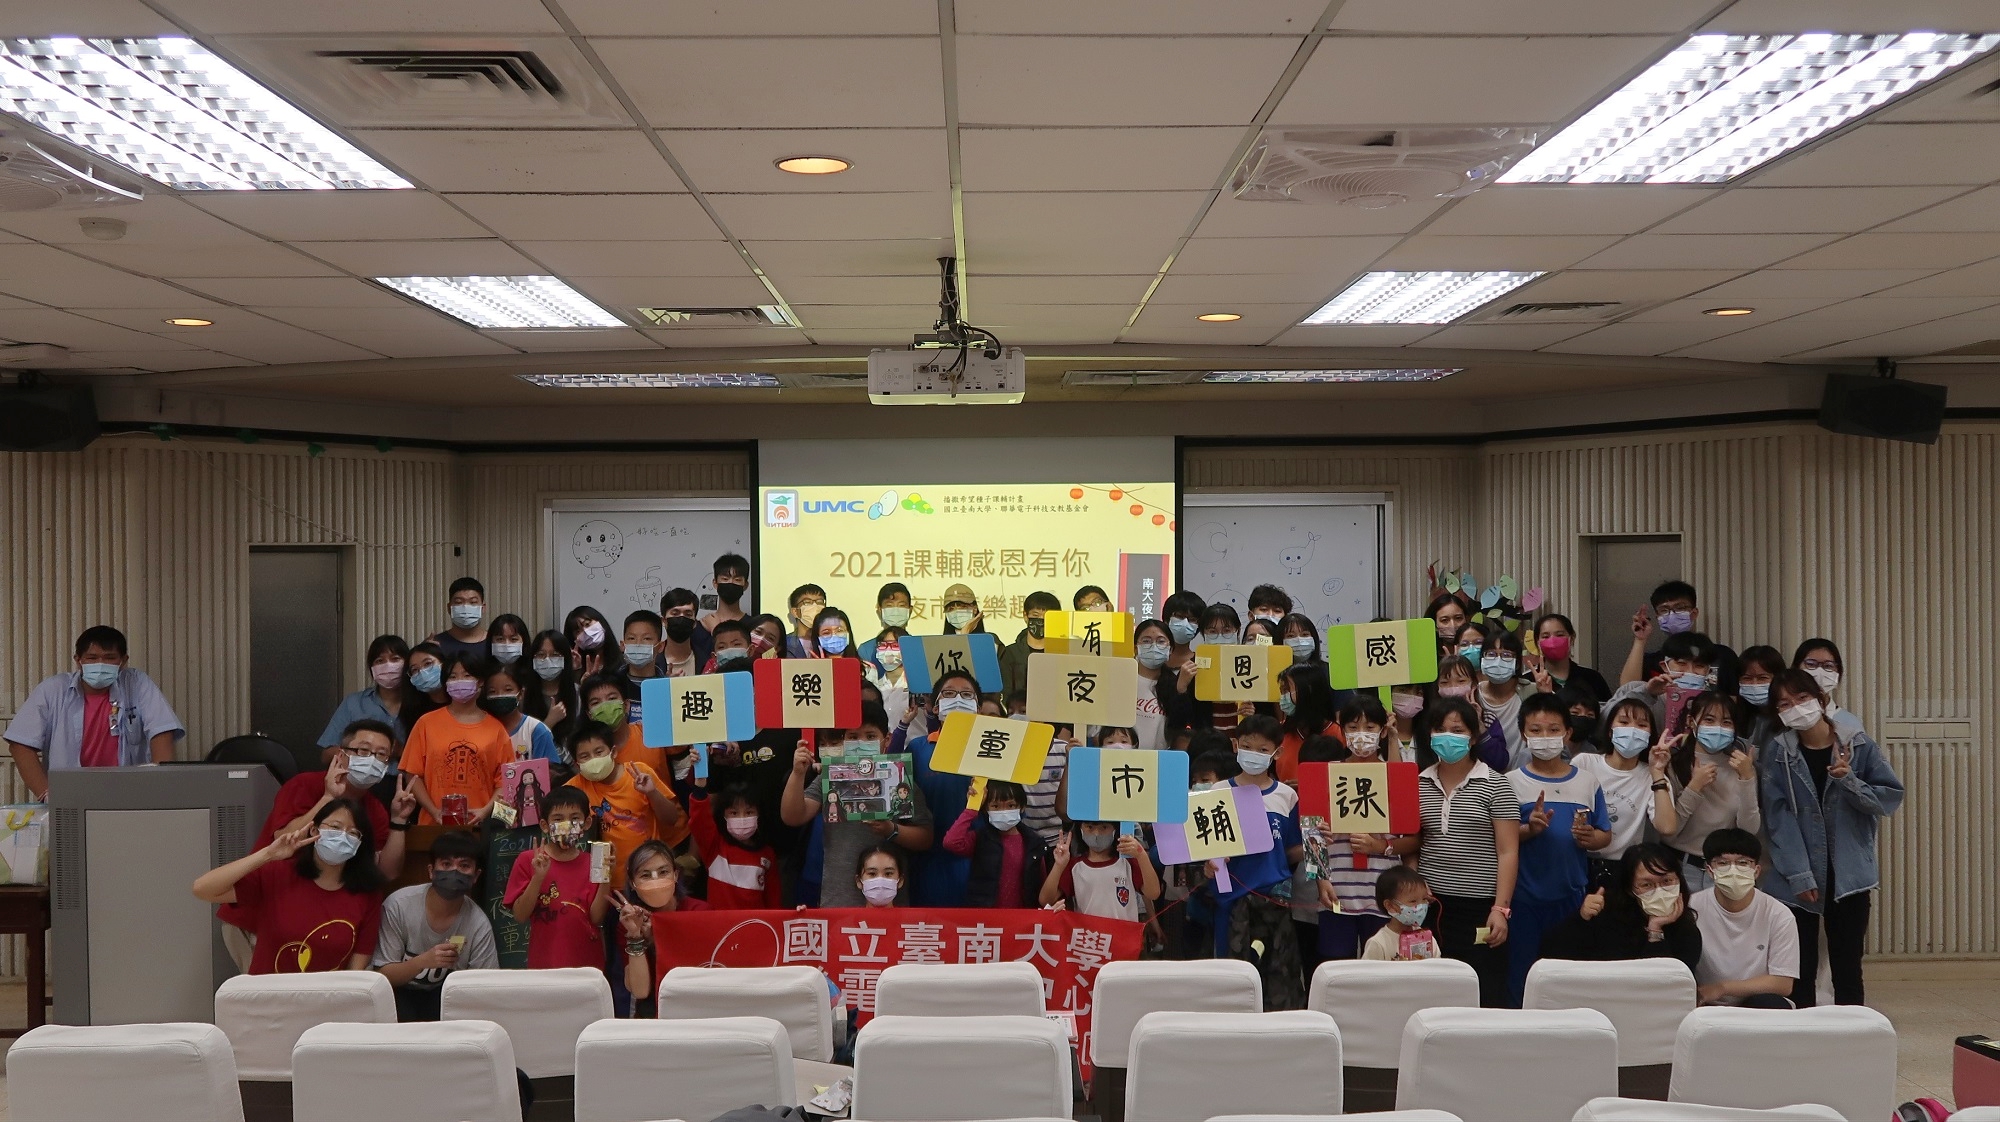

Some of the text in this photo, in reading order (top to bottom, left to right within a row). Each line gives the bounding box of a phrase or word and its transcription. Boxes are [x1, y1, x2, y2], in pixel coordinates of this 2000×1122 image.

[803, 501, 864, 513] UMC
[829, 548, 1091, 578] 2021課輔感恩有你
[1141, 578, 1154, 621] 南大夜
[1081, 621, 1101, 656] 有
[1365, 634, 1398, 668] 感
[1067, 670, 1097, 703] 夜
[1231, 655, 1260, 689] 恩
[681, 690, 713, 722] 趣
[792, 673, 822, 707] 樂
[976, 729, 1010, 760] 童
[1110, 764, 1145, 799] 市
[1335, 776, 1387, 820] 課
[1192, 800, 1236, 846] 輔
[781, 918, 1114, 972] 國立臺南大學
